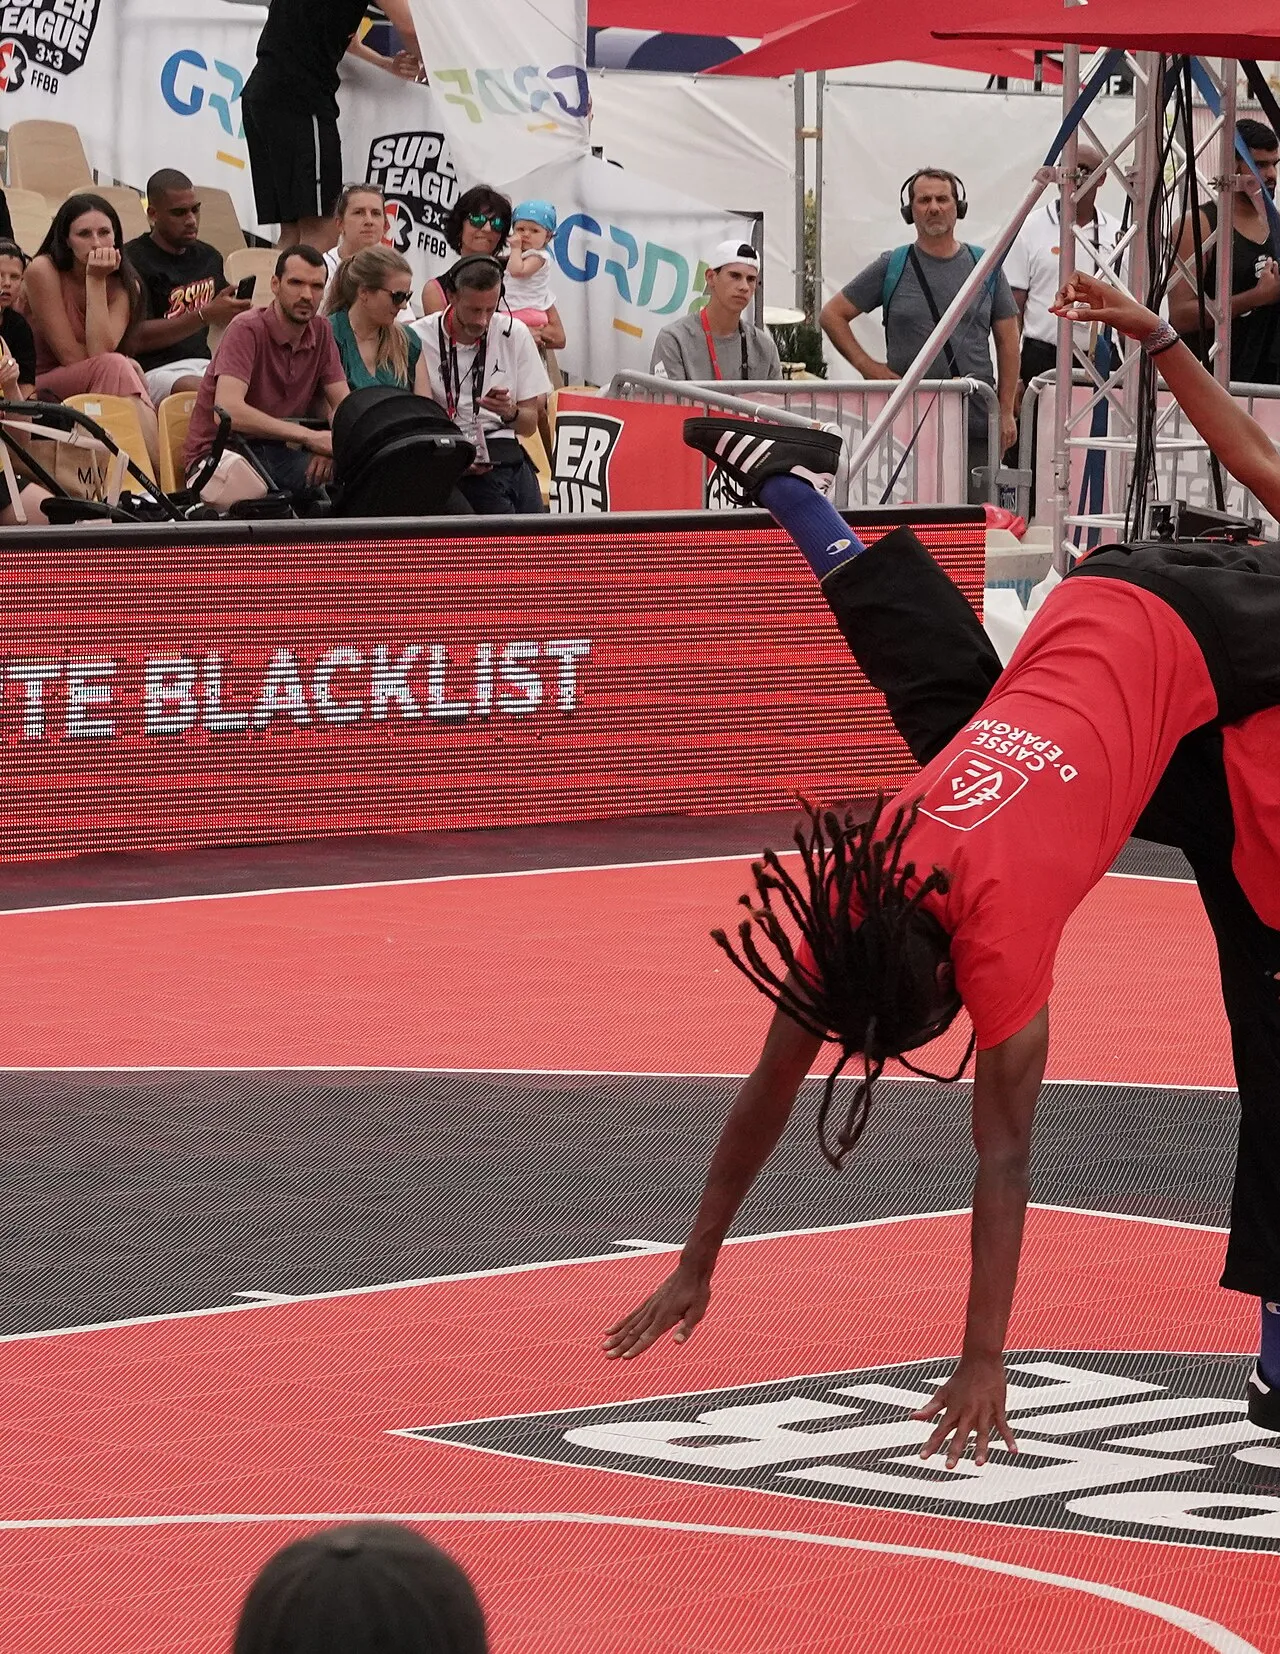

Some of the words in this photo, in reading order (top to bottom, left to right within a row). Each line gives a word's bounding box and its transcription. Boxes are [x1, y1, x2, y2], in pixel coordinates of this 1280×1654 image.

[0, 7, 90, 61] EAGUE
[35, 42, 63, 70] 3x3
[30, 69, 59, 95] FFBB
[160, 49, 247, 139] GR
[371, 134, 458, 181] SUPE
[369, 168, 461, 211] LEAGU
[422, 204, 447, 231] 3x
[417, 231, 447, 258] FFBB
[144, 639, 592, 738] BLACKLIST
[964, 718, 1079, 783] D'EPARGNE
[971, 732, 1046, 771] CAISSE
